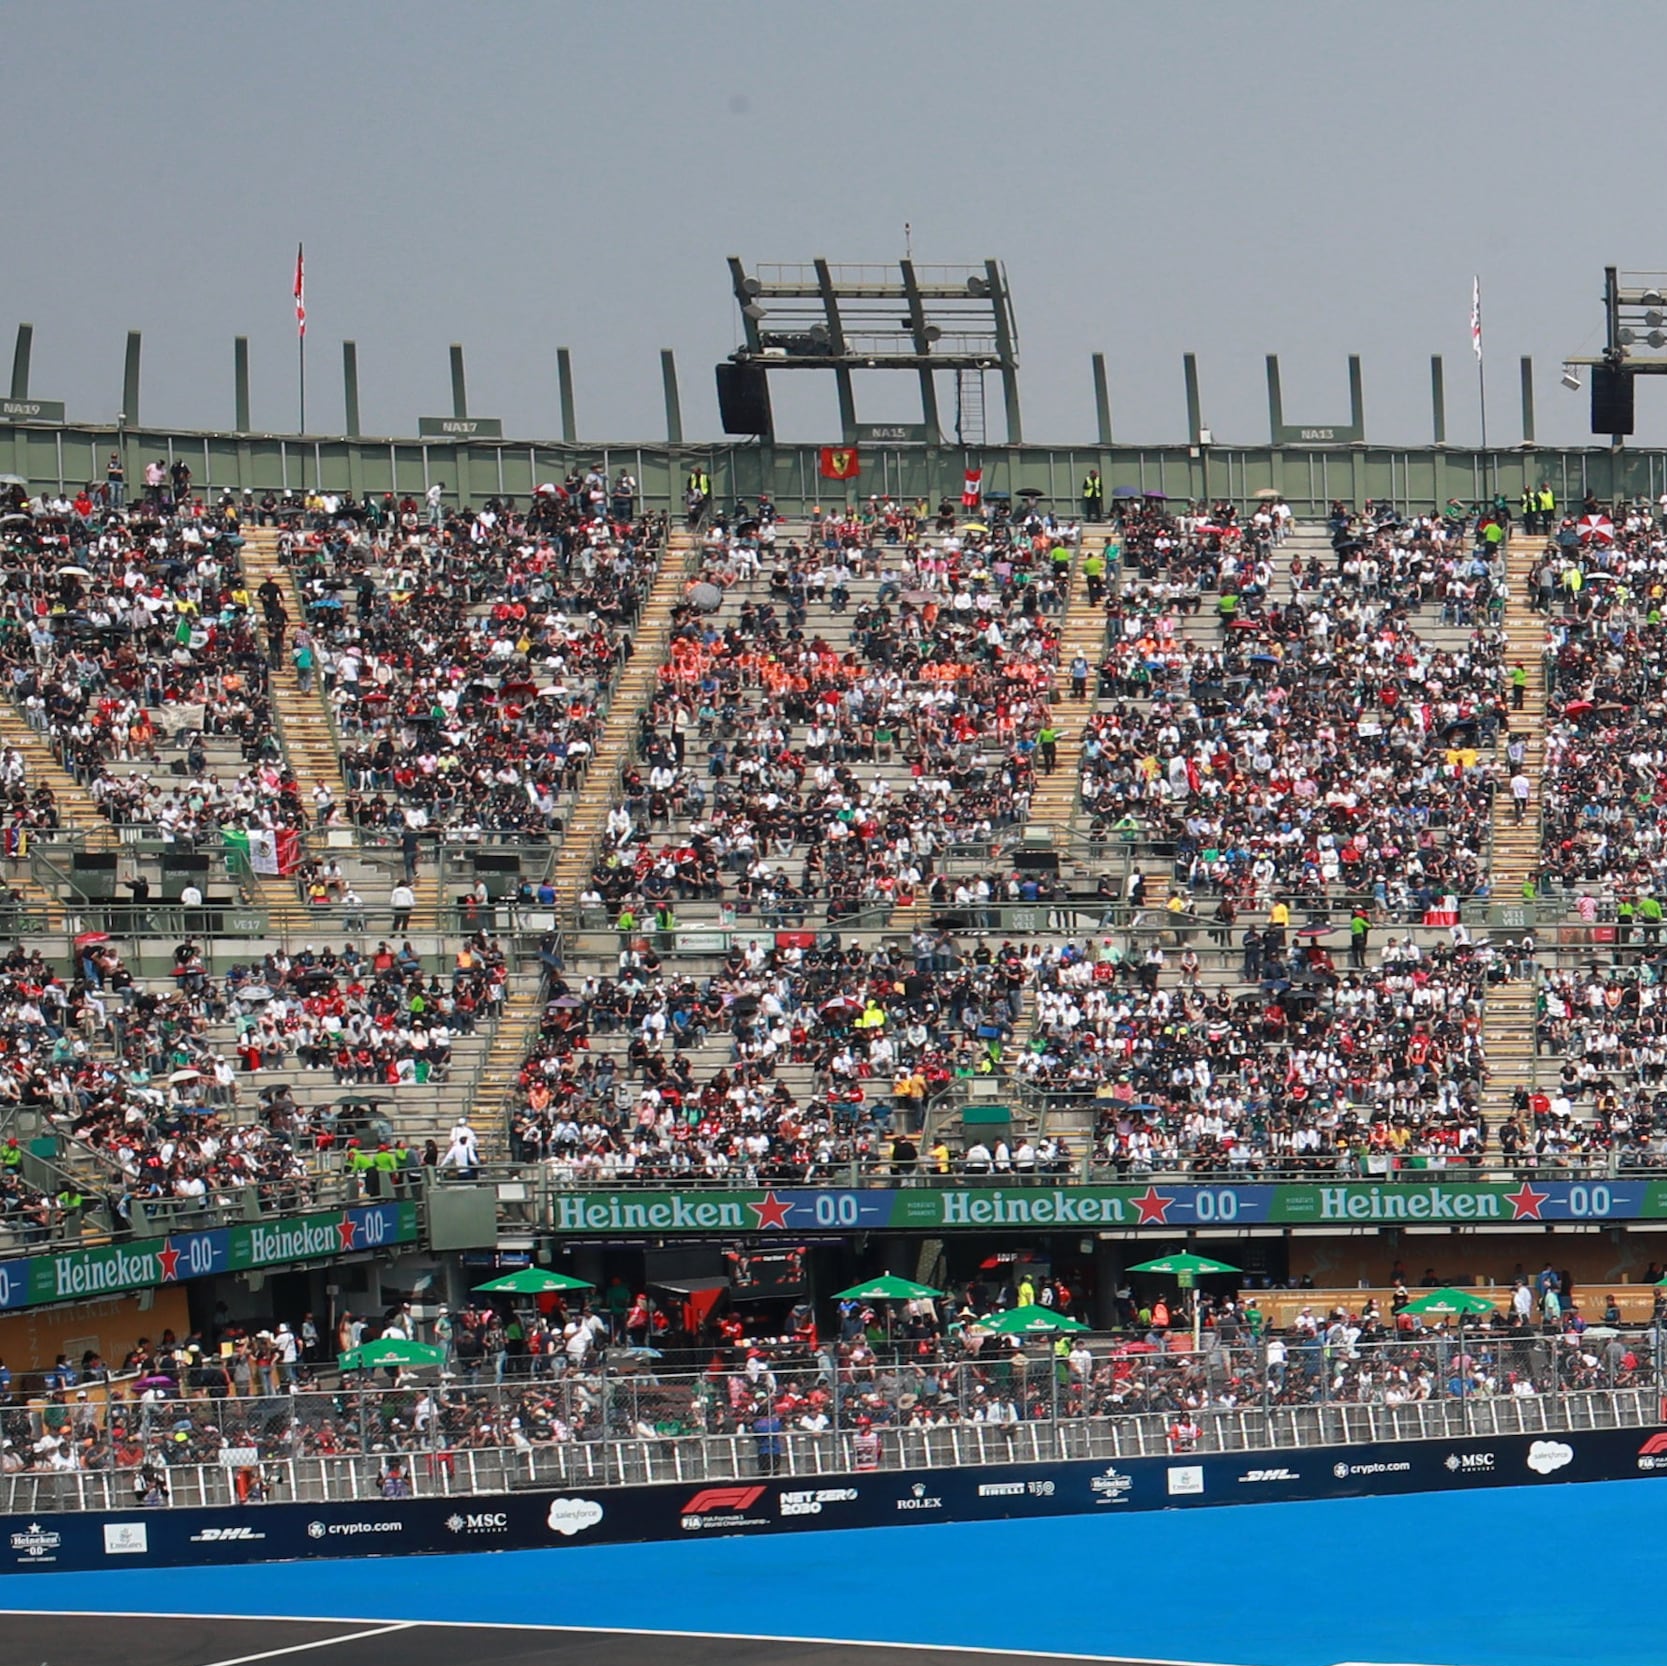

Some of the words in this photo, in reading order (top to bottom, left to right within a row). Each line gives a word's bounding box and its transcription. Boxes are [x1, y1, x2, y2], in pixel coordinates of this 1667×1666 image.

[4, 402, 41, 415] NA19
[442, 422, 478, 433] NA17
[872, 428, 906, 438] NA15
[1301, 430, 1334, 440] NA13
[233, 919, 261, 930] VE17
[942, 1192, 1124, 1224] Heineken
[1196, 1190, 1238, 1221] 0.0
[1320, 1187, 1499, 1218] Heineken
[1569, 1186, 1610, 1216] 0.0
[558, 1196, 743, 1229] Heineken
[815, 1195, 858, 1226] 0.0
[251, 1221, 336, 1263] Heineken
[364, 1210, 384, 1244] 0.0
[55, 1250, 155, 1295] Heineken
[191, 1237, 213, 1273] 0.0
[1461, 1452, 1495, 1467] MSC
[1246, 1468, 1291, 1482] DHL
[1350, 1460, 1410, 1475] crypto.com
[780, 1490, 815, 1505] NET
[816, 1487, 858, 1503] ZERO
[978, 1482, 1026, 1498] PIRELLI
[780, 1502, 822, 1517] 2030
[897, 1497, 942, 1510] ROLEX
[467, 1512, 508, 1528] MSC
[555, 1509, 598, 1520] salesforce
[200, 1527, 256, 1542] DHL
[328, 1521, 402, 1537] crypto.com
